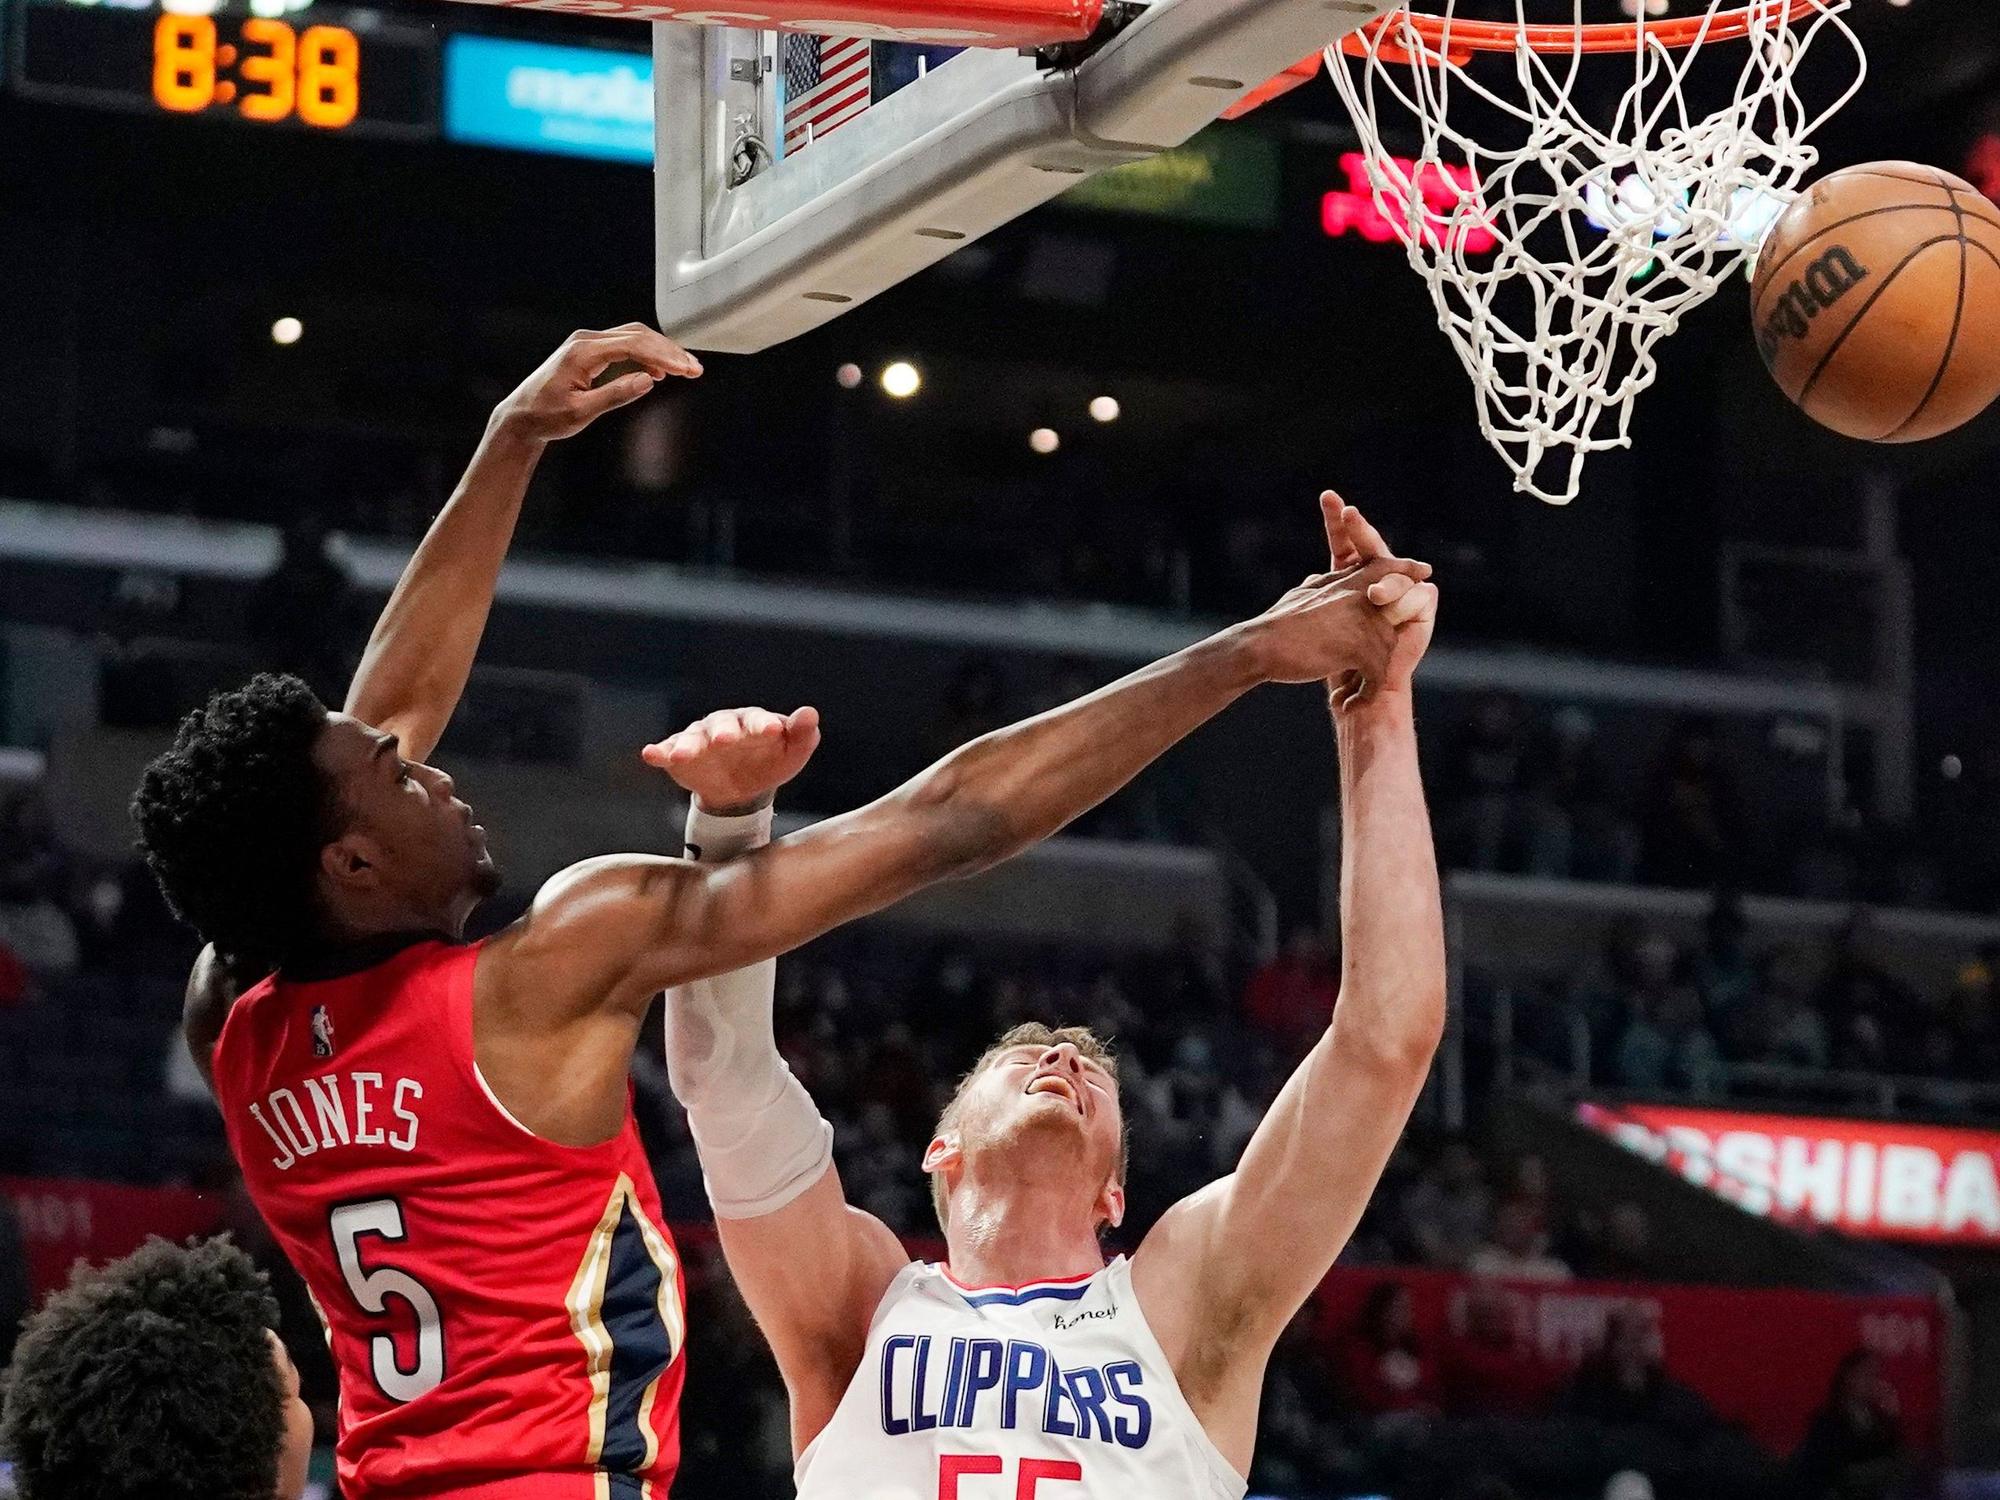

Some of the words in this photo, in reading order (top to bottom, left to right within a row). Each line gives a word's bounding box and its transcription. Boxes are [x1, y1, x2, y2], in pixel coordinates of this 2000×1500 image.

[154, 13, 360, 128] 8:38
[249, 1071, 423, 1170] JONES
[330, 1198, 445, 1403] 5
[880, 1334, 1152, 1450] CLIPPERS
